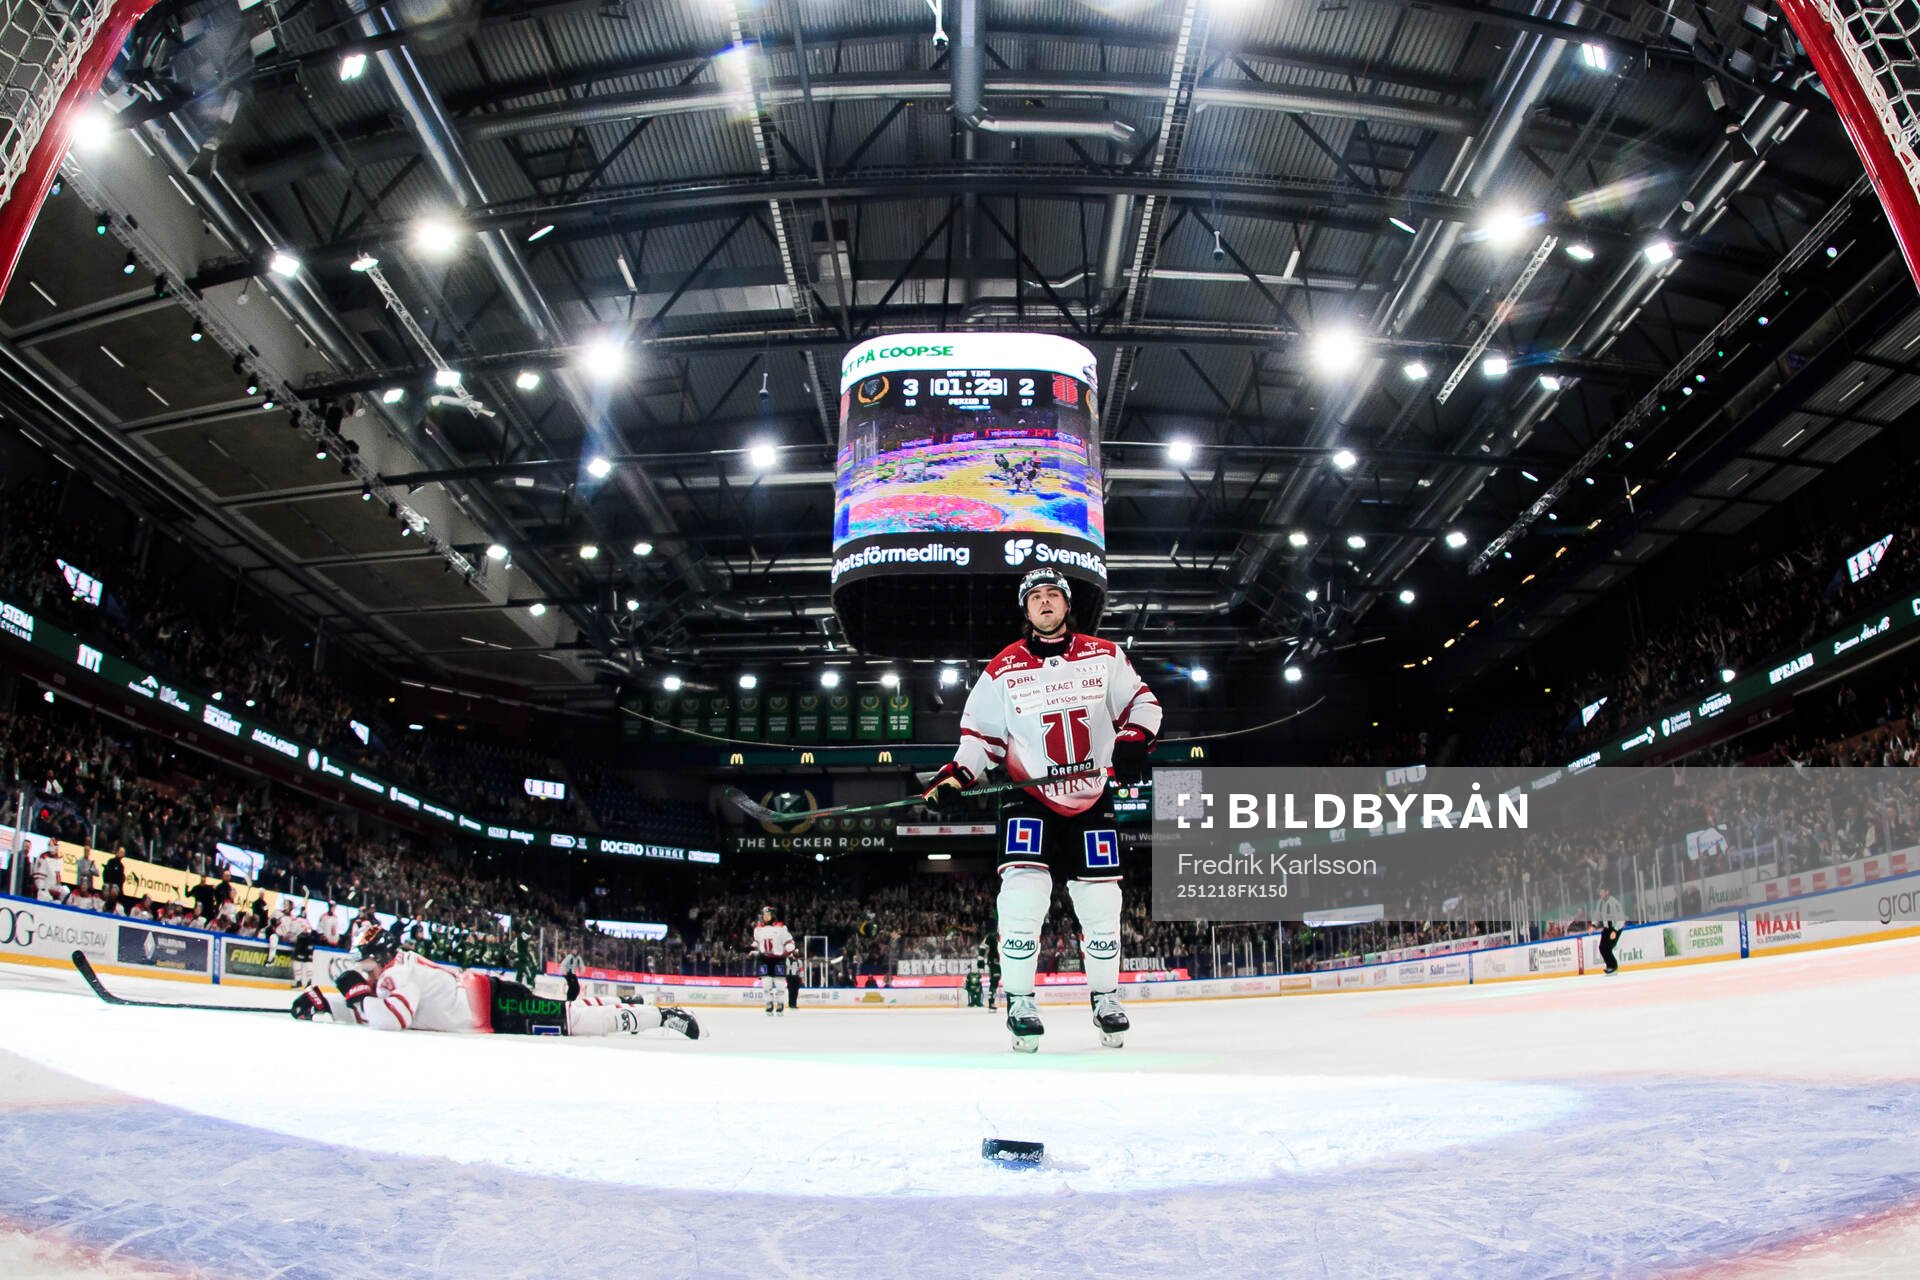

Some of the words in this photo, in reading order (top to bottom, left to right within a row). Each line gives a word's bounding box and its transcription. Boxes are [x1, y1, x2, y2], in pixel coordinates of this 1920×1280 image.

[857, 349, 875, 367] PÅ
[879, 346, 954, 358] COOPSE
[971, 370, 991, 378] TIME
[902, 378, 919, 396] 3
[934, 378, 1003, 396] 01:29
[1018, 378, 1035, 396] 2
[948, 398, 980, 406] PERIOD
[1016, 674, 1036, 684] BRL
[1081, 677, 1102, 687] OBK
[1051, 762, 1092, 776] ÖREBRO
[737, 838, 766, 848] THE
[772, 837, 833, 848] LOCKER
[839, 837, 886, 848] ROOM
[1120, 832, 1137, 841] The
[600, 840, 644, 856] DOCERO
[645, 845, 685, 860] LOUNGE
[1755, 911, 1801, 937] MAXI
[1689, 925, 1724, 938] CARLSSON
[1001, 939, 1036, 951] MOAB
[1692, 937, 1724, 949] PERSSON
[1619, 948, 1643, 962] frakt
